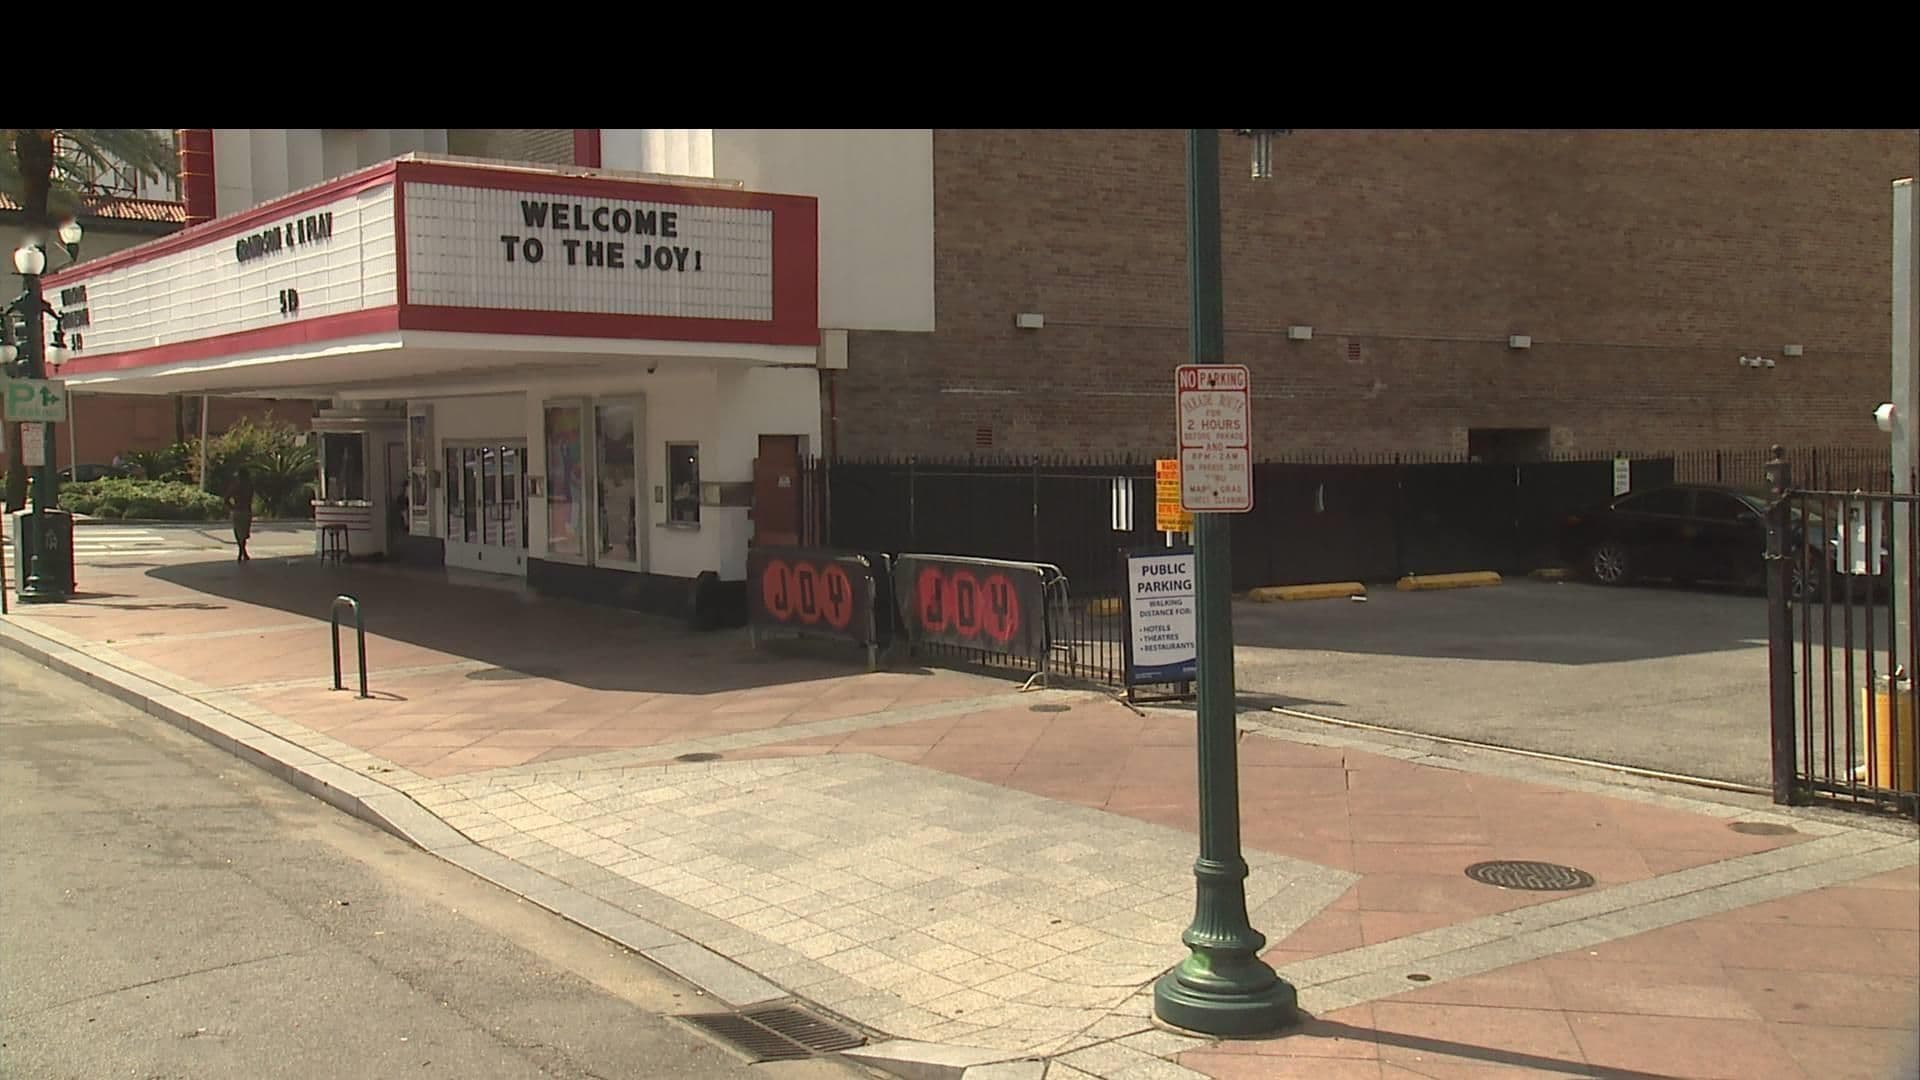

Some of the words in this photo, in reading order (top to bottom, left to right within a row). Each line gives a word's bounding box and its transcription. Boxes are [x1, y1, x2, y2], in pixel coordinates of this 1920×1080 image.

[521, 201, 678, 238] WELCOME
[501, 235, 544, 264] TO
[563, 240, 625, 269] THE
[635, 244, 702, 272] JOY!
[1180, 370, 1196, 388] NO
[1200, 371, 1244, 387] PARKING
[1187, 419, 1194, 430] 2
[1201, 419, 1241, 430] HOURS
[1206, 443, 1223, 451] AND
[1142, 563, 1186, 577] PUBLIC
[774, 567, 845, 617] JOY
[1137, 579, 1192, 593] PARKING
[927, 574, 1008, 635] JOY
[1149, 599, 1183, 608] WALKING
[1139, 609, 1174, 618] DISTANCE
[1143, 625, 1171, 633] HOTELS
[1144, 633, 1179, 642] THEATRES
[1144, 642, 1195, 652] RESTAURANTS
